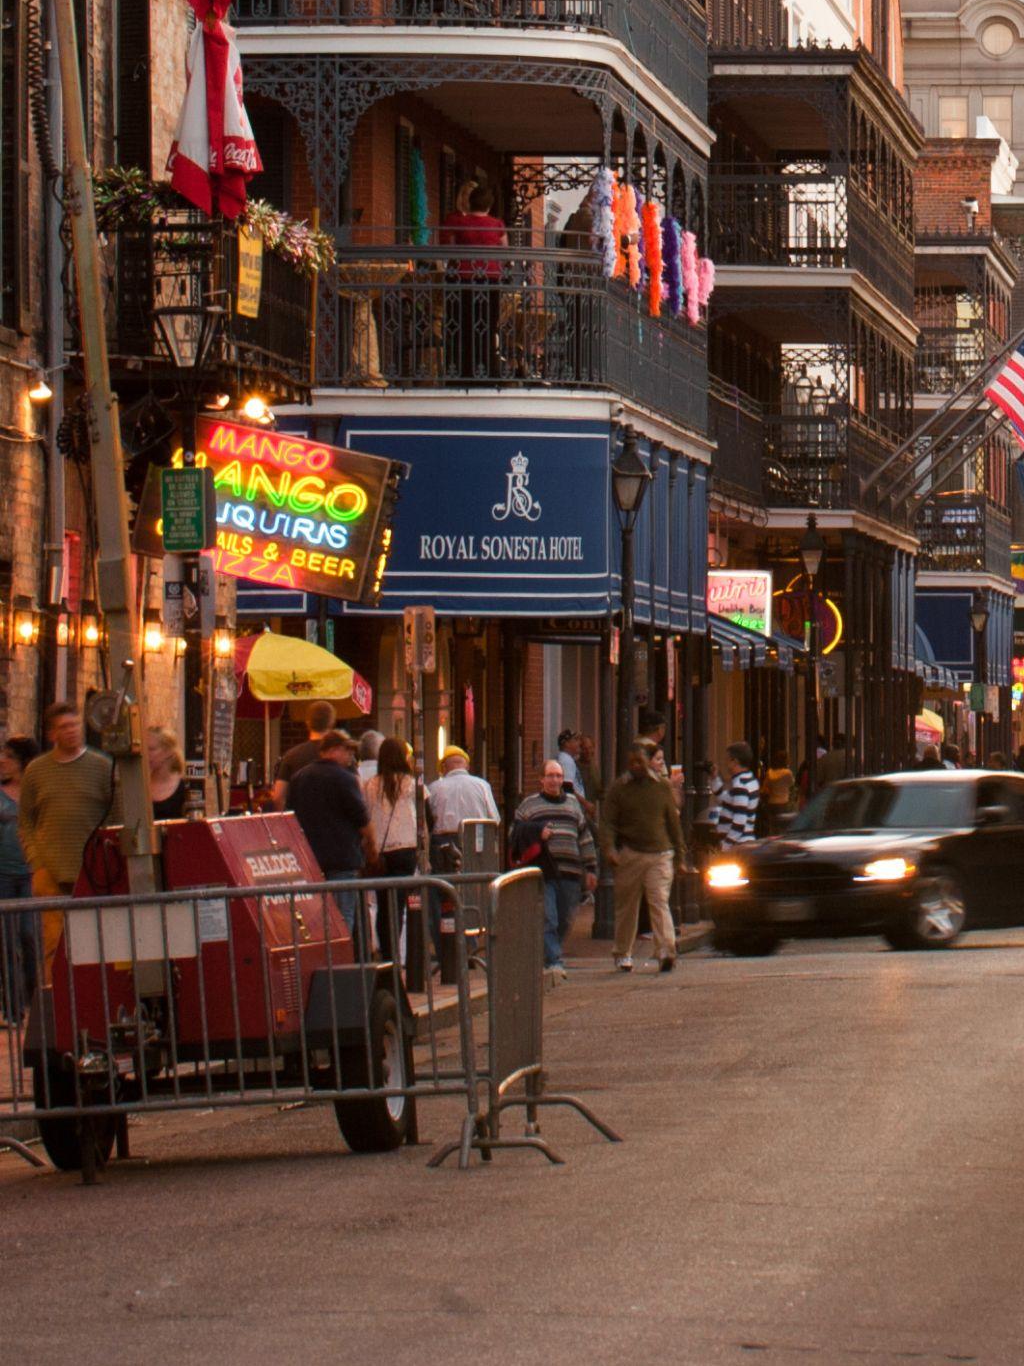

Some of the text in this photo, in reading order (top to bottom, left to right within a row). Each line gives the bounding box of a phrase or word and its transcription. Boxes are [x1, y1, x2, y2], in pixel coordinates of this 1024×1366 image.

[209, 425, 330, 471] MANGO
[262, 541, 280, 562] &
[290, 548, 356, 580] BEER
[420, 535, 583, 560] ROYAL SONESTA HOTEL
[209, 549, 296, 587] IZZA
[246, 852, 302, 877] BALDOR
